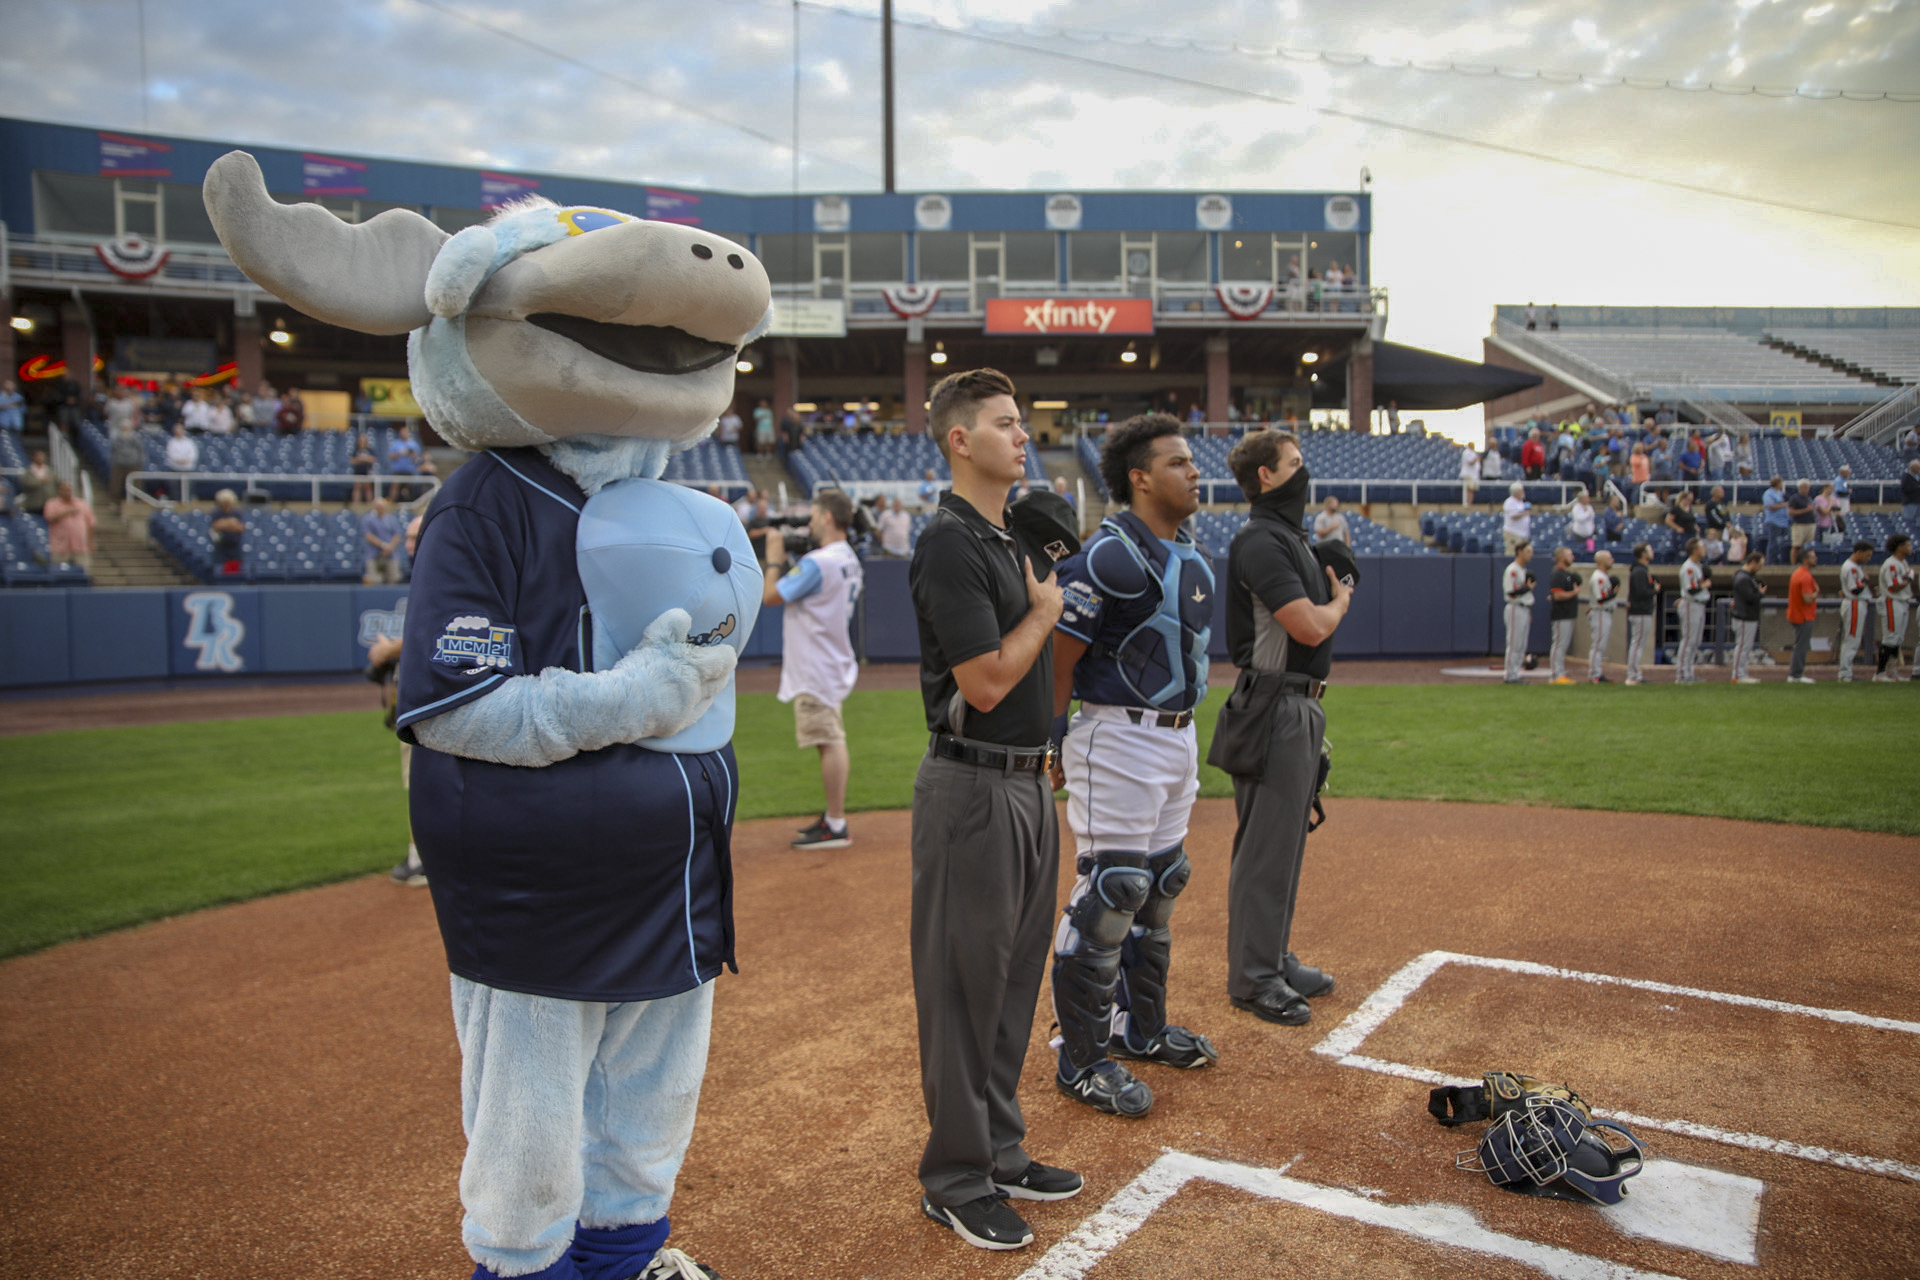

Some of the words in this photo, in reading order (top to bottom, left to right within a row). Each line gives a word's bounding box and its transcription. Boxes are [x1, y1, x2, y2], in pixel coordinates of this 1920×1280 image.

[1023, 299, 1117, 333] xfinity
[1773, 415, 1798, 429] GA
[448, 639, 485, 654] MCM
[491, 643, 508, 656] 21
